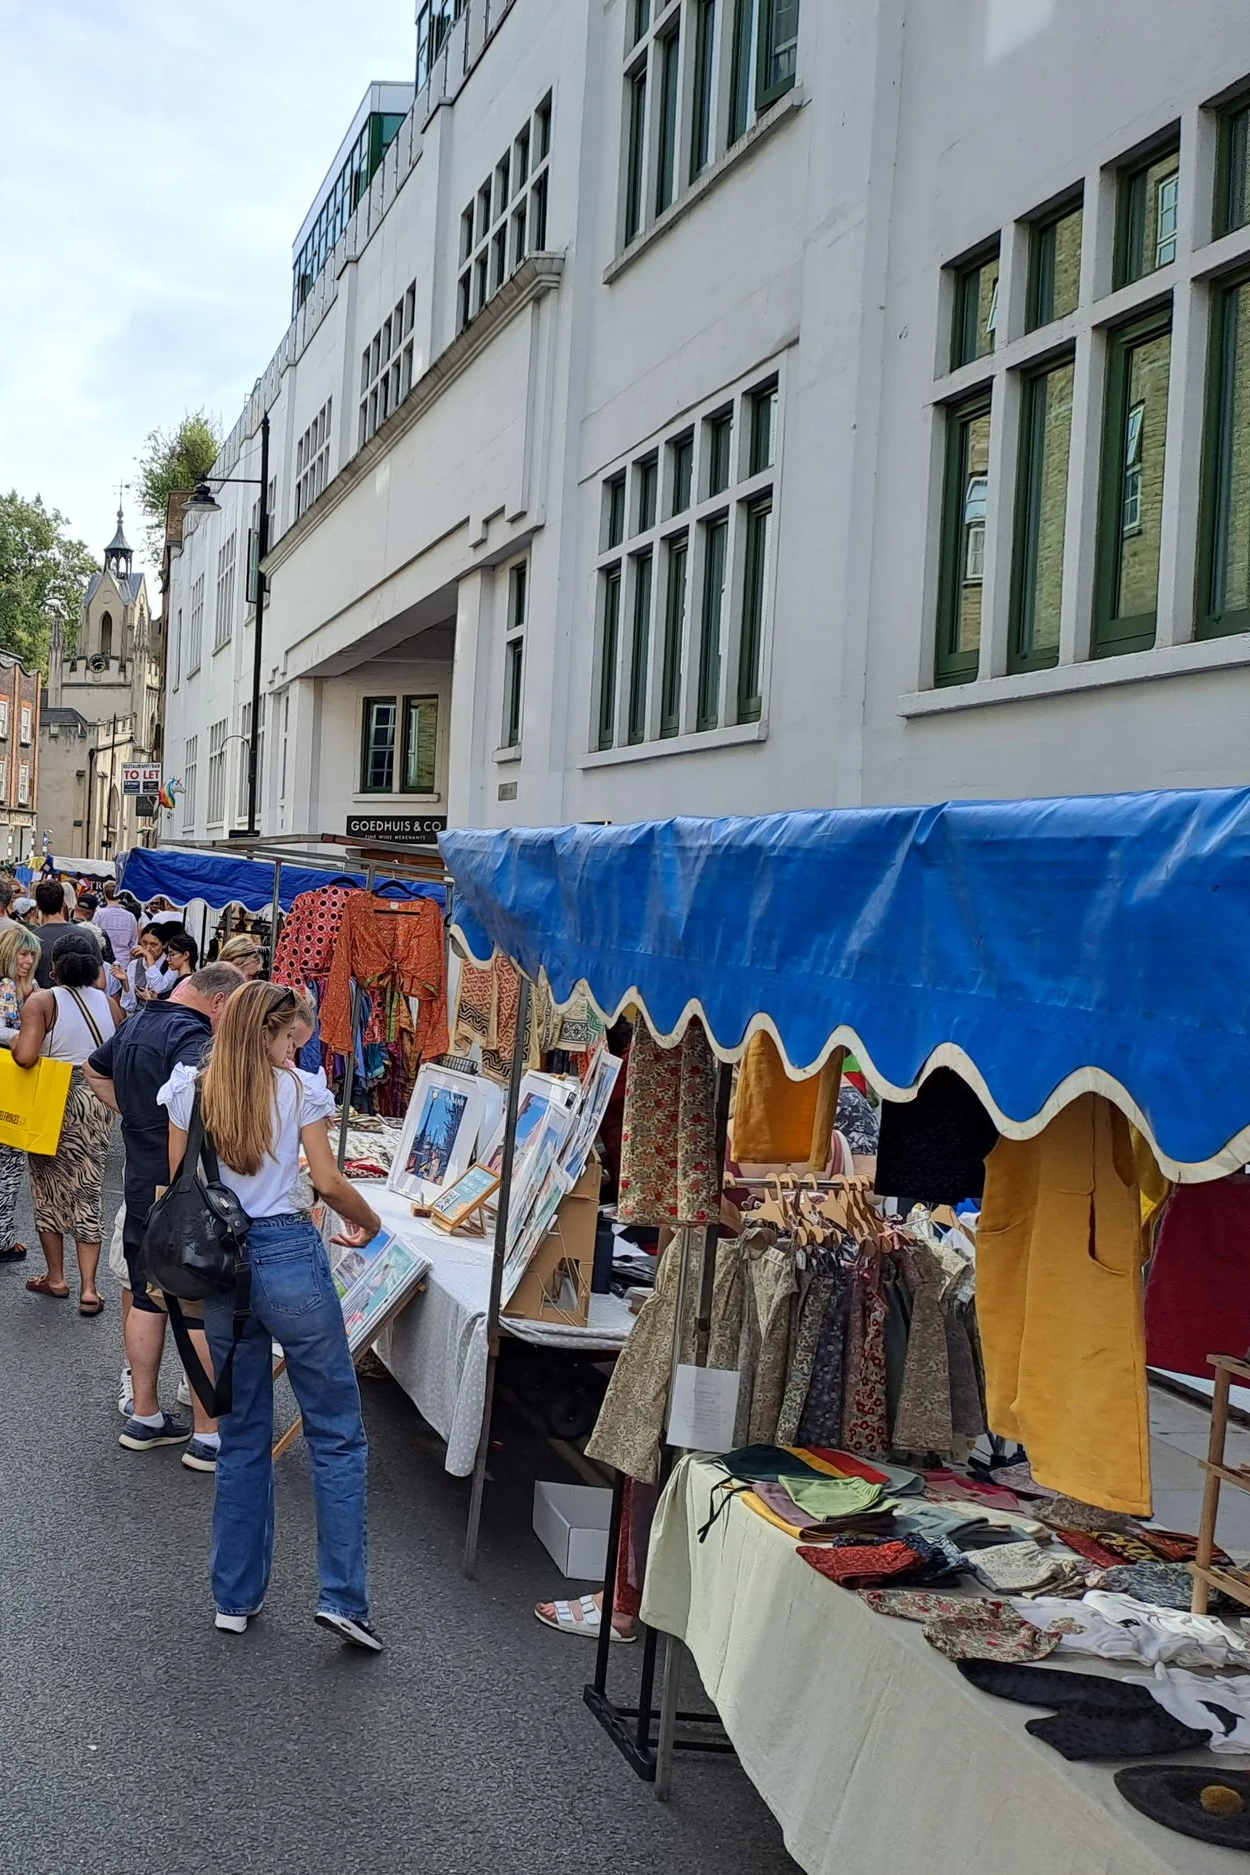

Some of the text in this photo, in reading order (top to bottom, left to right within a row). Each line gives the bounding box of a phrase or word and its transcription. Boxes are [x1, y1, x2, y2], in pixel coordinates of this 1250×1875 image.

[124, 770, 160, 780] TO LET
[350, 821, 441, 832] GOEDHUIS & CO
